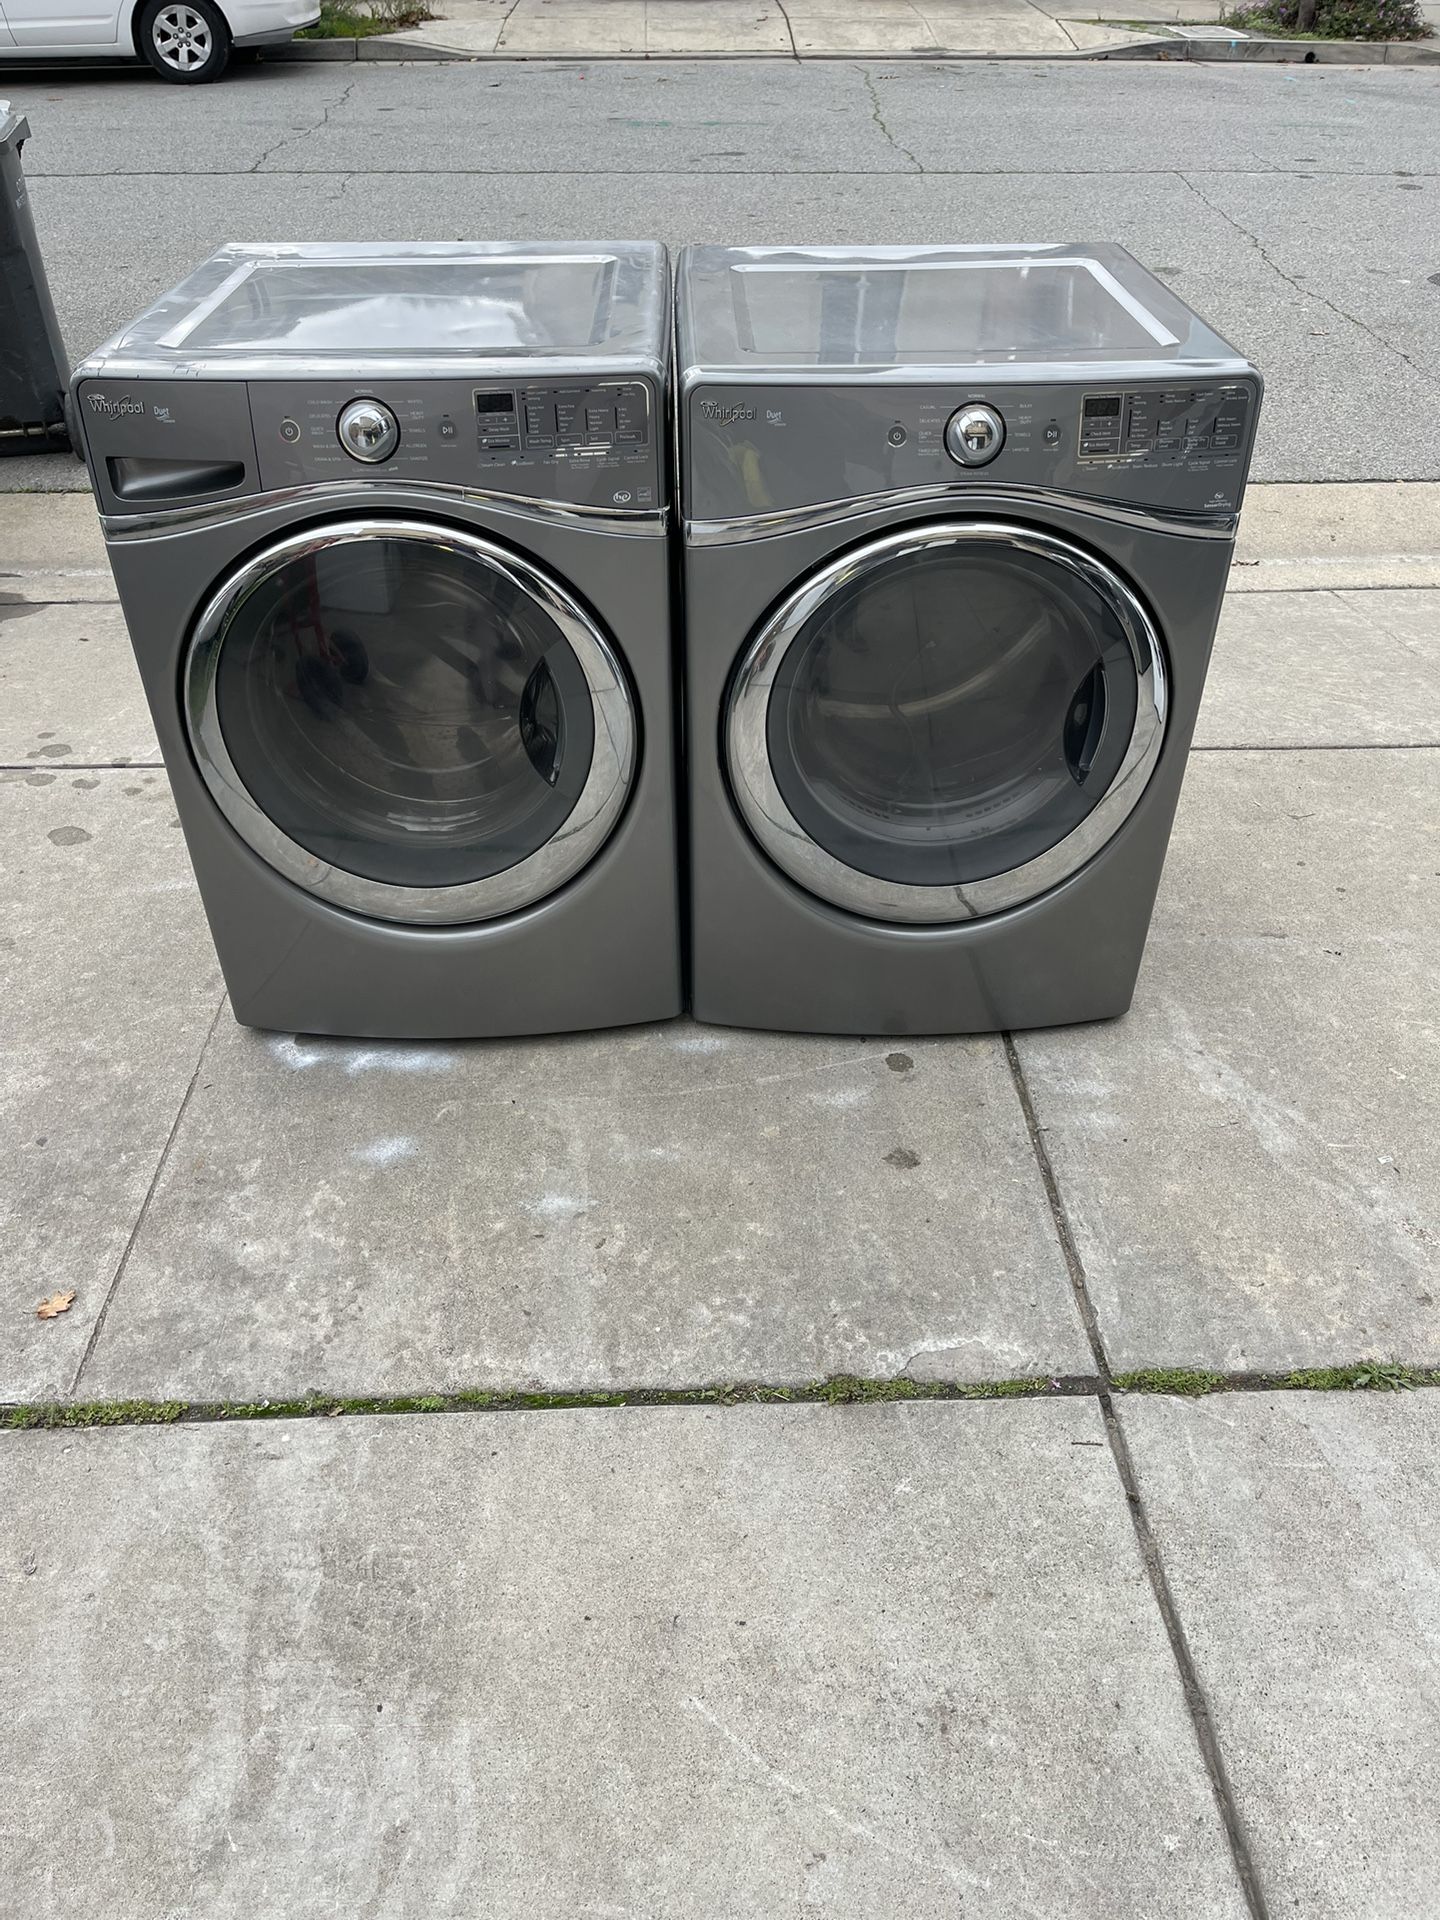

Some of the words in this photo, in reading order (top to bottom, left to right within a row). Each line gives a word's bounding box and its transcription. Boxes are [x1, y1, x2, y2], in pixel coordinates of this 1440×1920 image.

[90, 397, 145, 418] Whirlpool
[153, 406, 169, 416] Duet
[701, 403, 757, 424] Whirlpool
[766, 409, 782, 419] Duet
